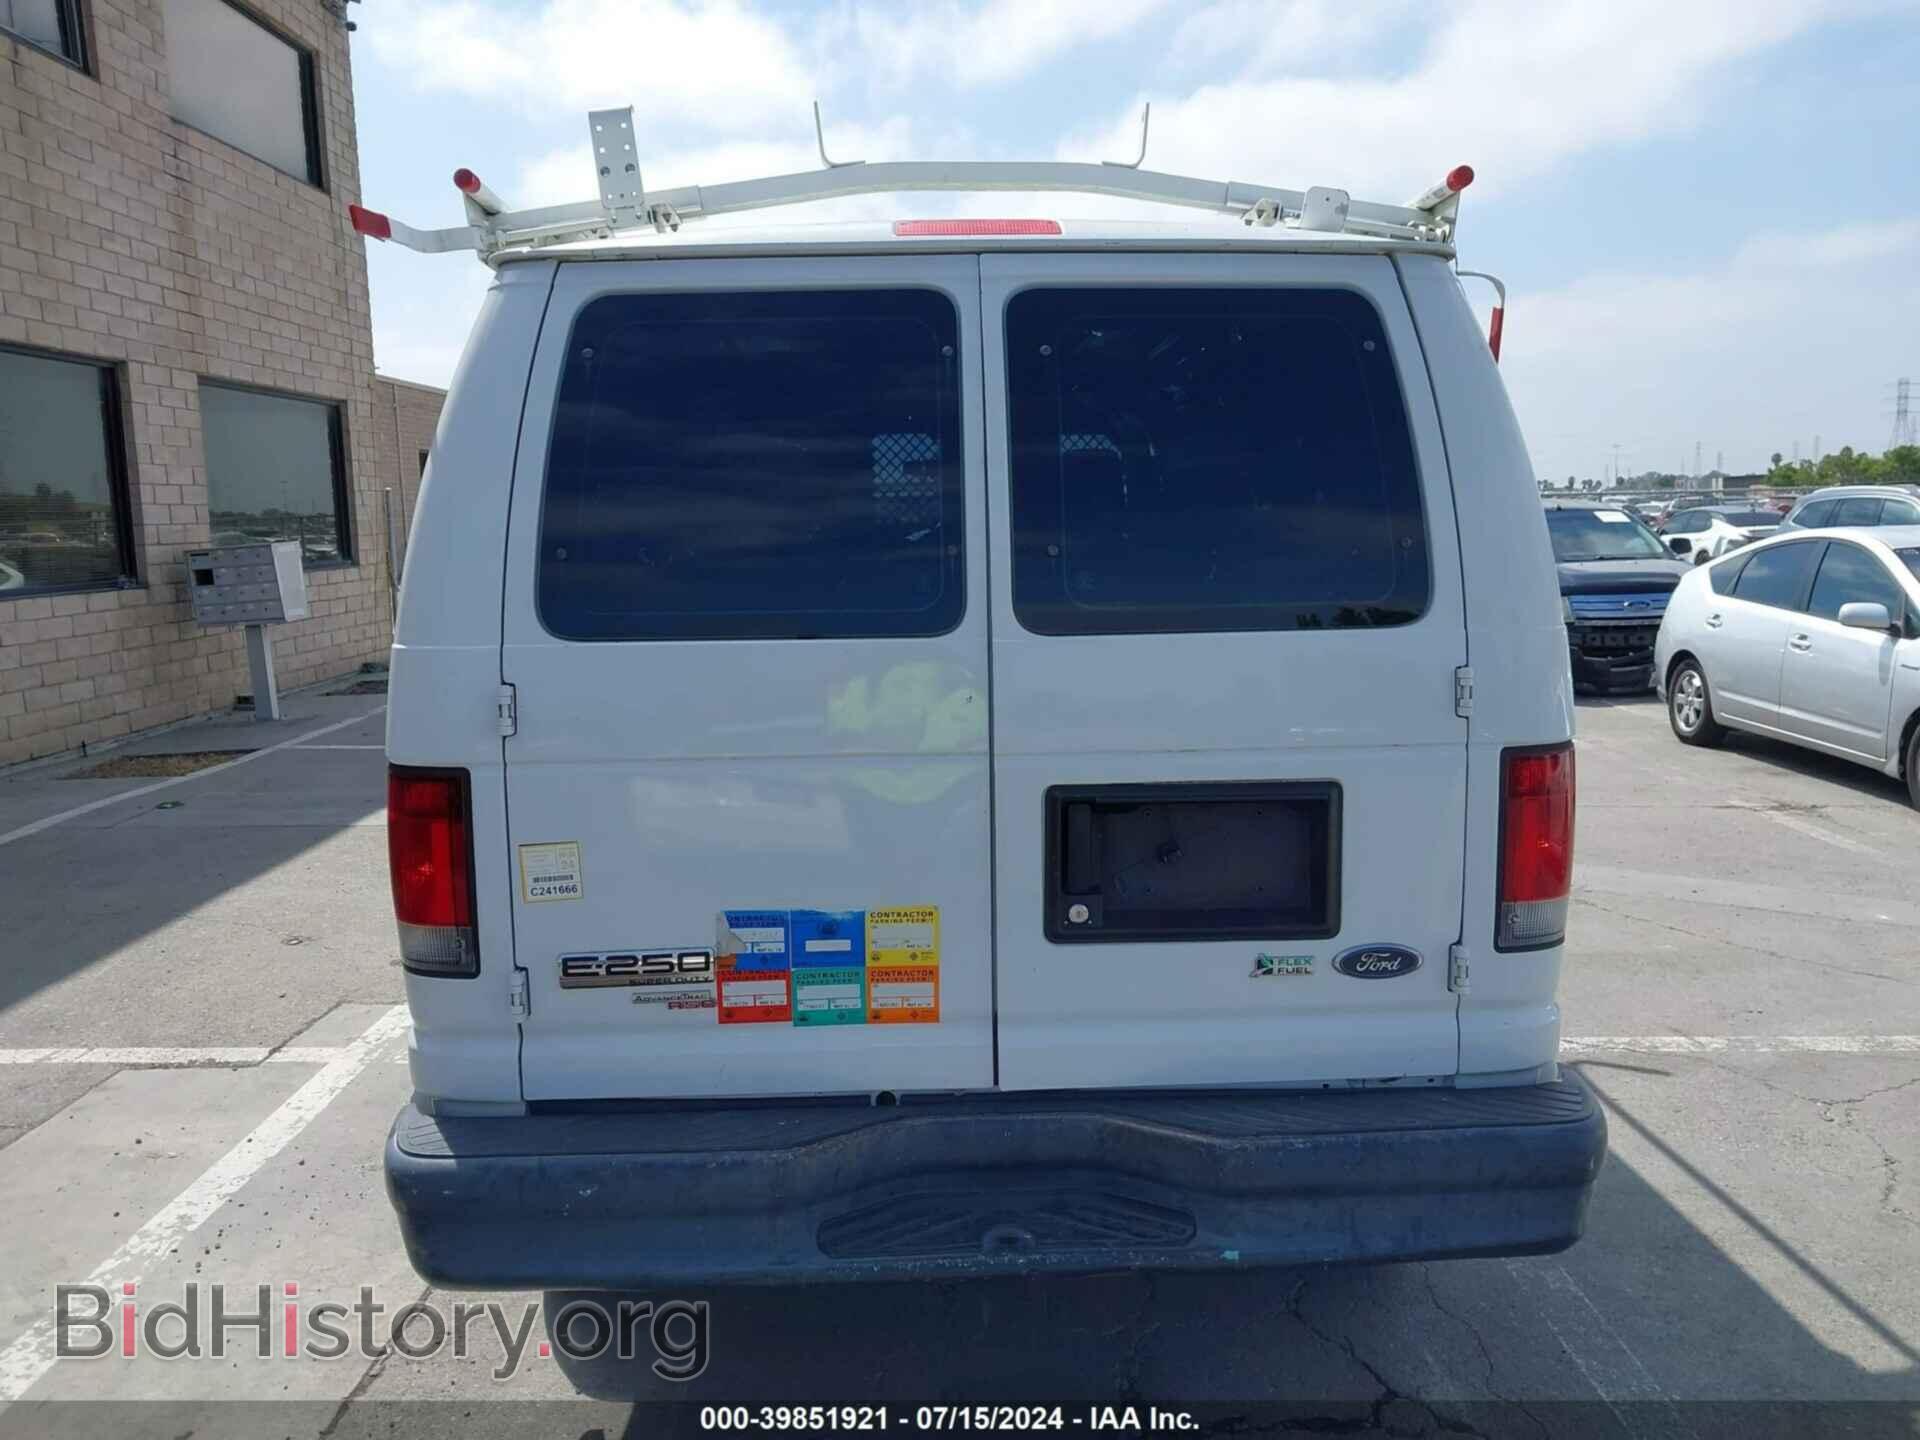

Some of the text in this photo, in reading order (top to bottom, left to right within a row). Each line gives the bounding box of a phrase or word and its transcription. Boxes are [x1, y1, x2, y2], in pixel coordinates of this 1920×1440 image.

[530, 884, 578, 896] C241666
[870, 911, 934, 919] CONTRACTOR
[561, 951, 710, 977] E-250
[1277, 956, 1313, 966] FLEX
[1356, 952, 1402, 972] Ford
[871, 969, 934, 978] CONTRACTOR
[1277, 966, 1312, 975] FUEL
[796, 971, 860, 980] CONTRACTOR
